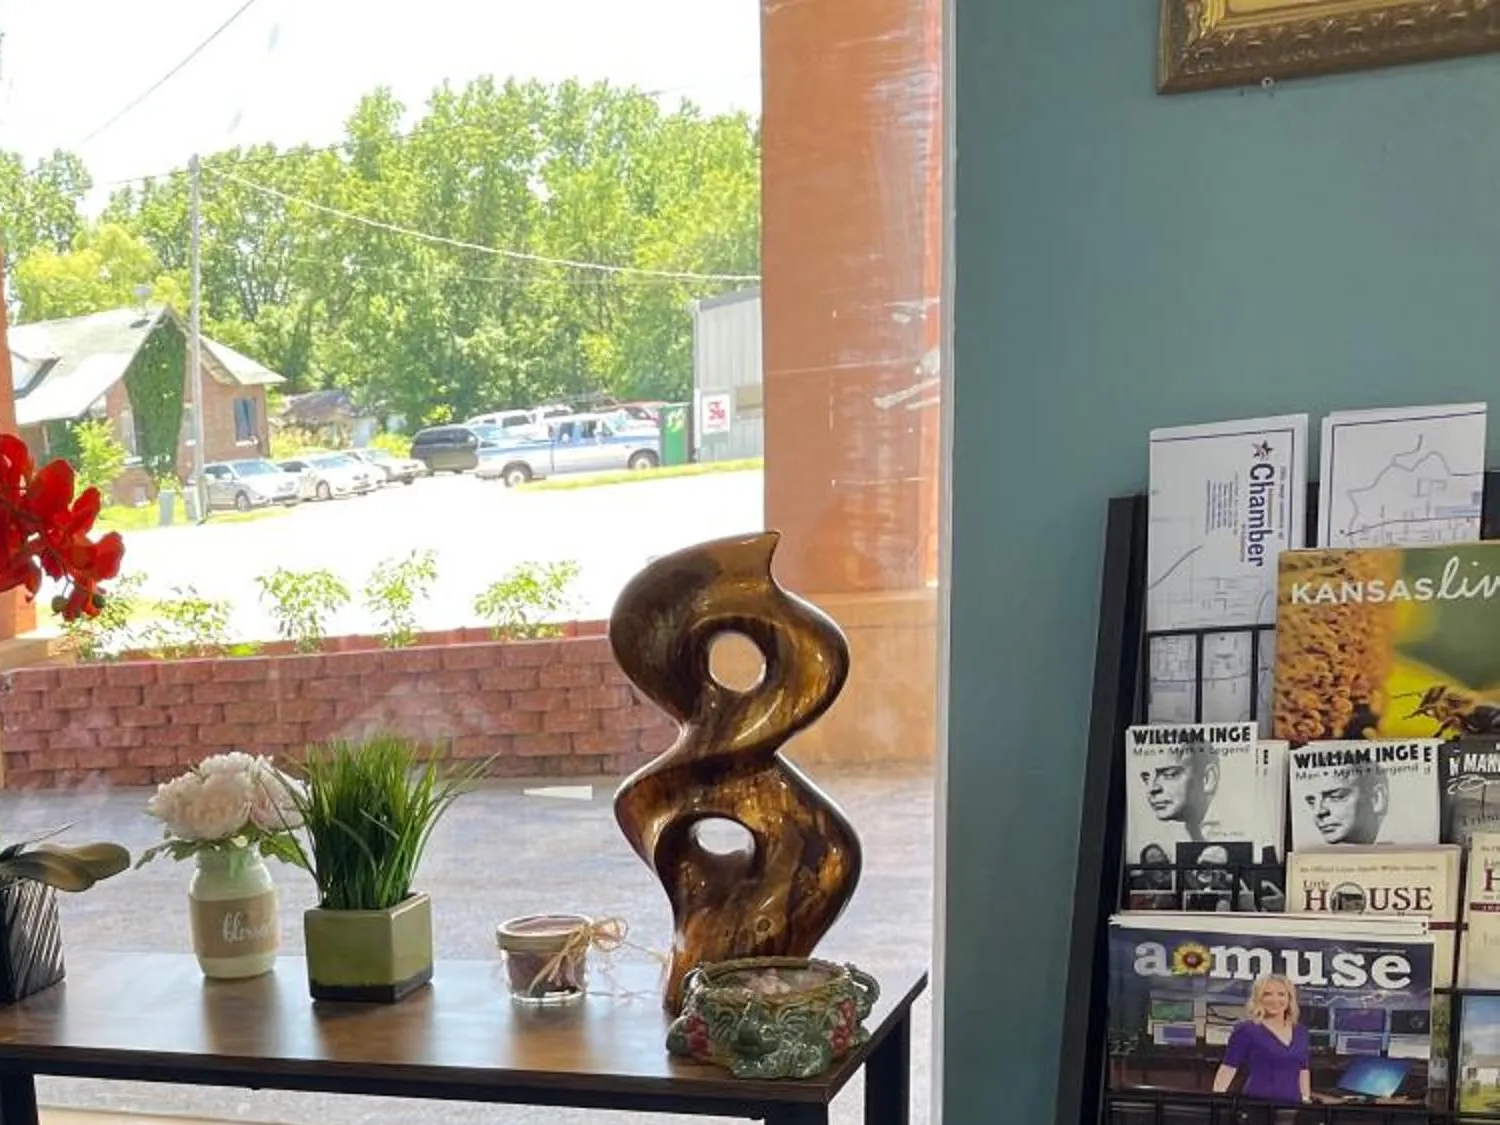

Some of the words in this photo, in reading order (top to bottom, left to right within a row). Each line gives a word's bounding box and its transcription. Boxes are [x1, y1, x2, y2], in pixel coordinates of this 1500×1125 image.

[1247, 463, 1275, 568] Chamber
[1132, 728, 1205, 745] WILLIAM
[1209, 726, 1251, 743] INGE
[1294, 748, 1371, 769] WILLIAM
[1375, 745, 1419, 763] INGE
